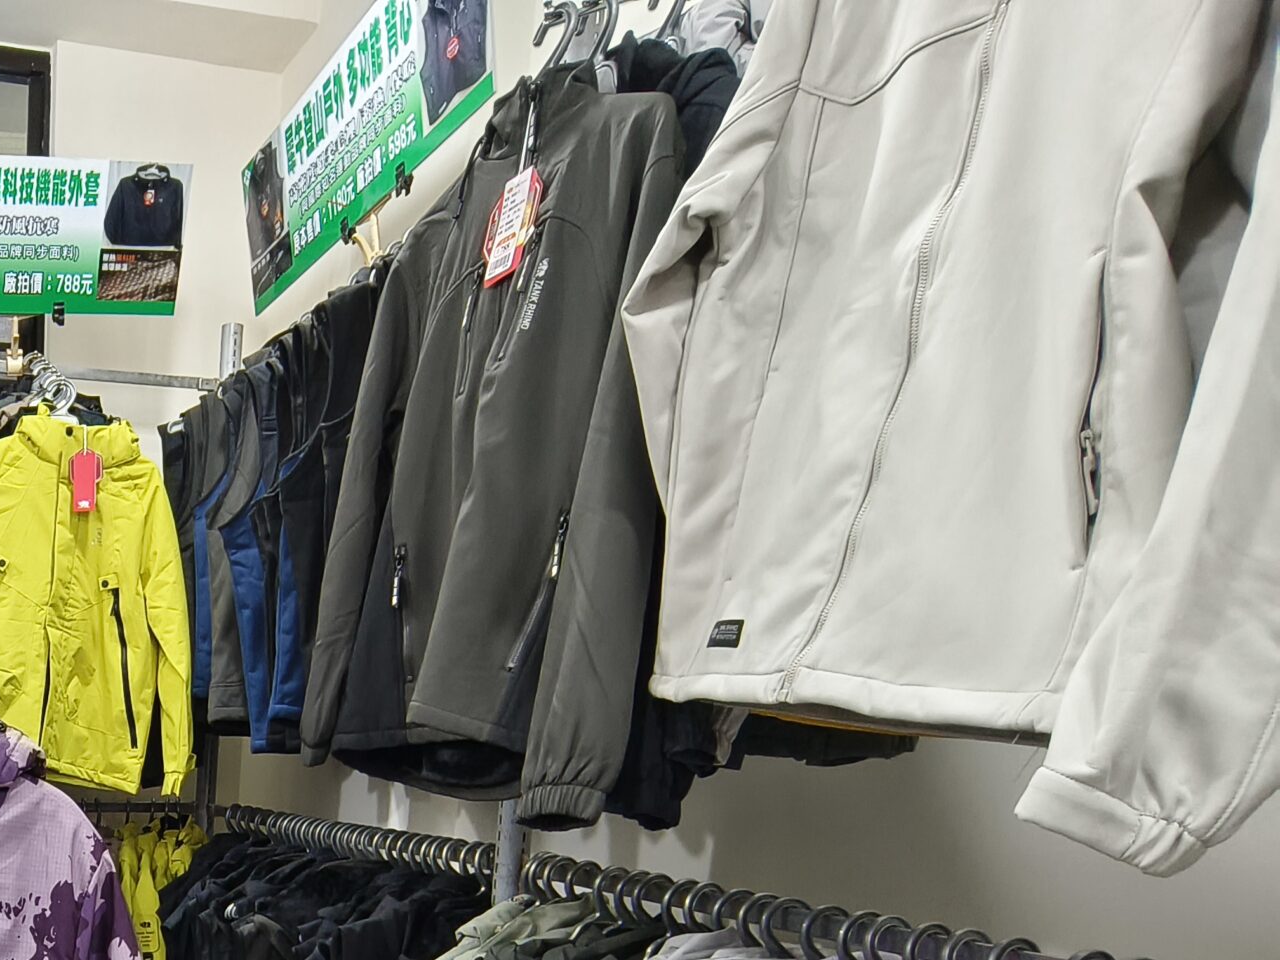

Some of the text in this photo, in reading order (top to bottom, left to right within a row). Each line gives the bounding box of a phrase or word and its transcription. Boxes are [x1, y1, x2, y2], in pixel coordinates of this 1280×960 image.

[284, 0, 412, 176] 犀牛登山戶外 多功能 背心
[528, 278, 544, 303] TANK
[519, 301, 537, 330] RHINO
